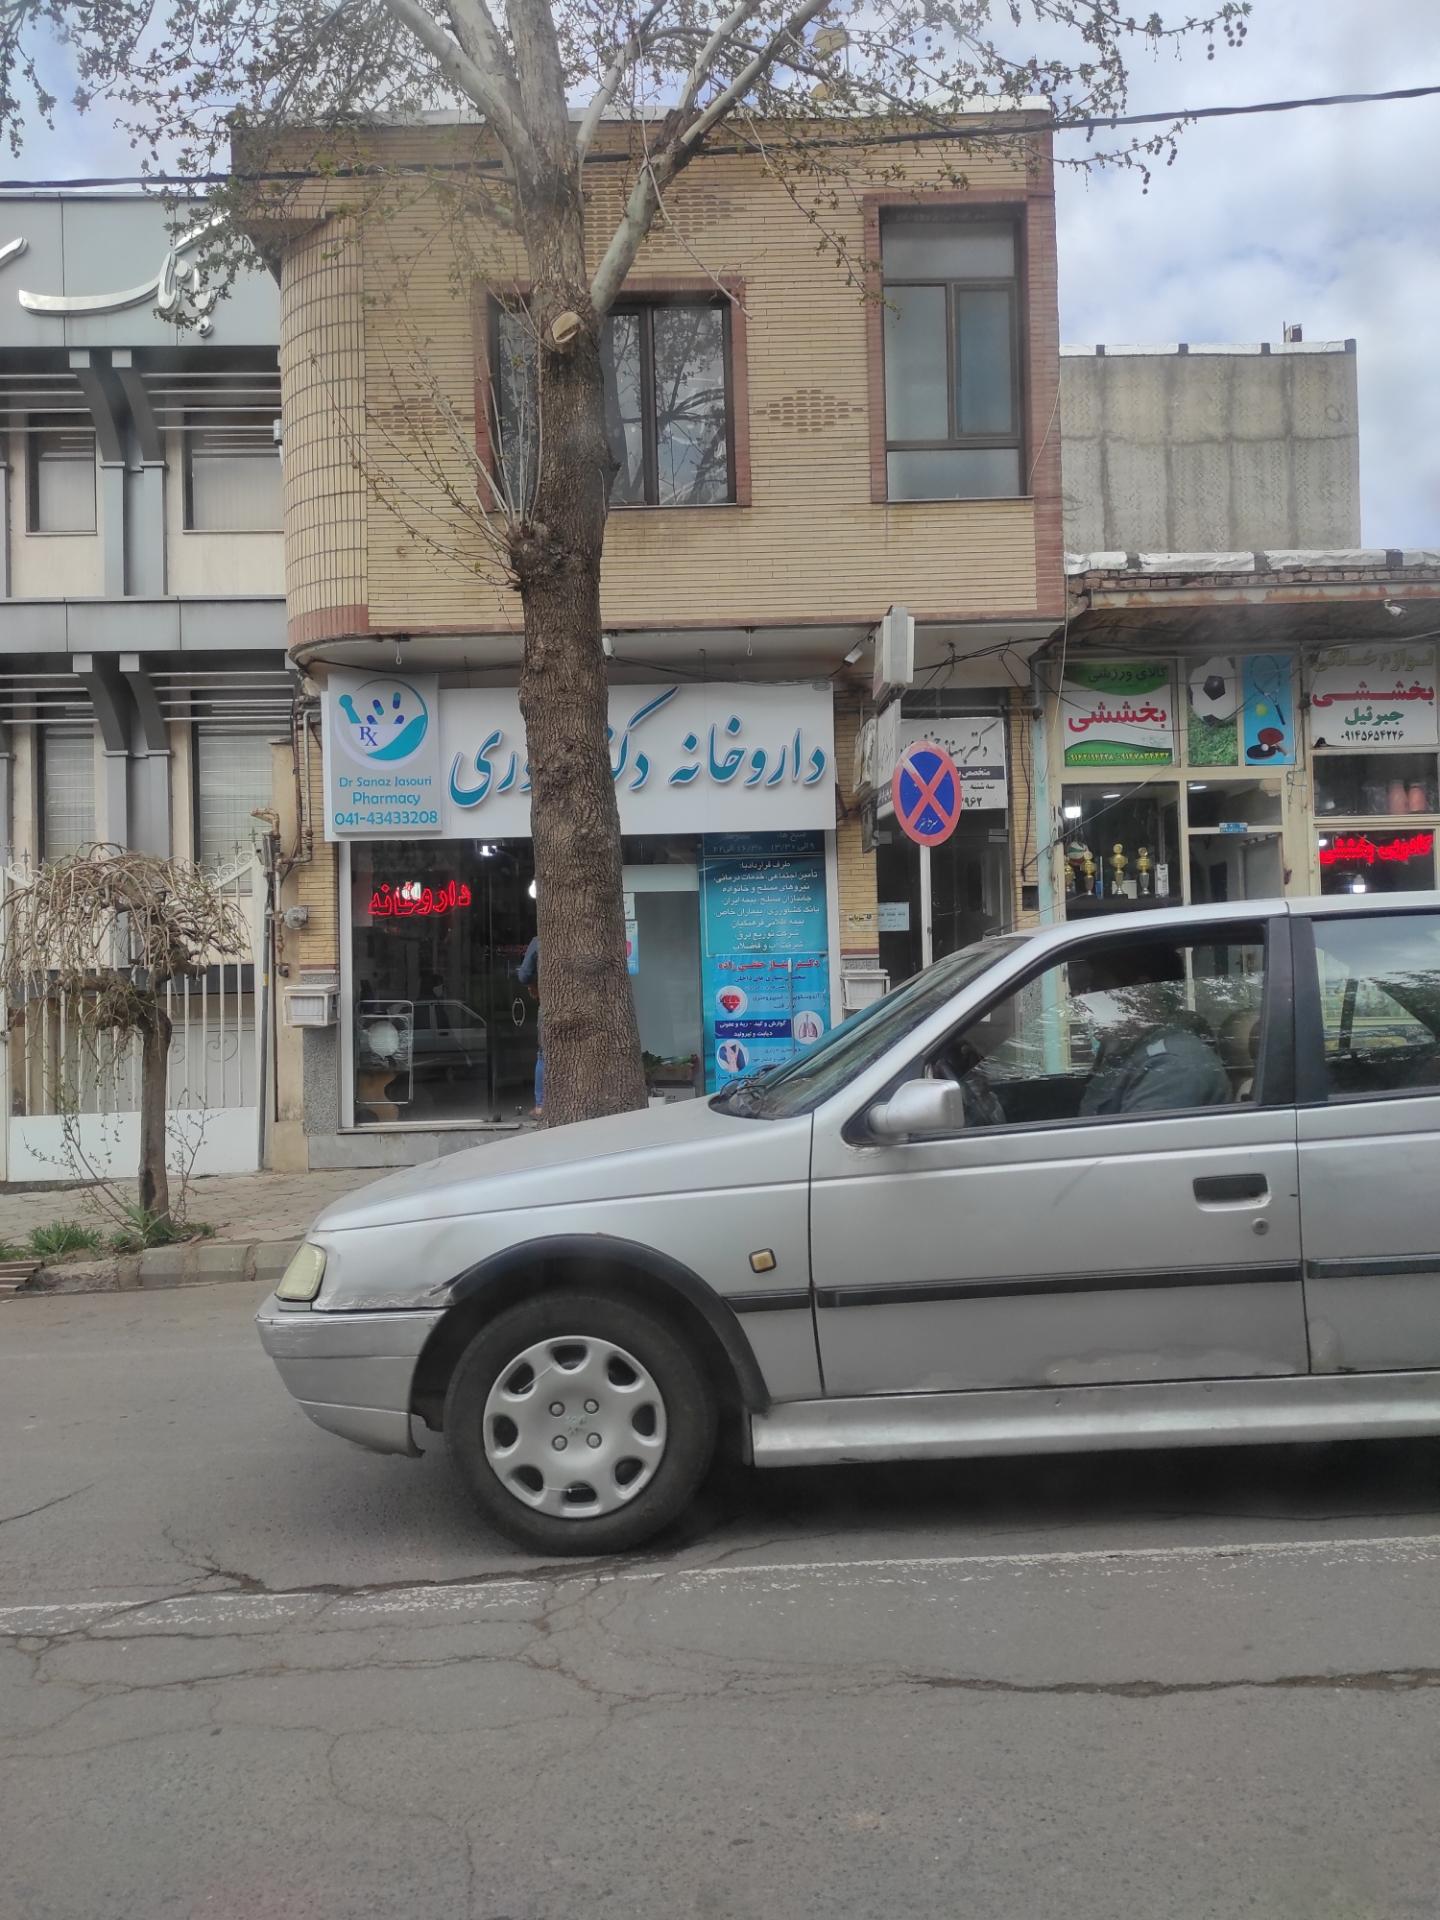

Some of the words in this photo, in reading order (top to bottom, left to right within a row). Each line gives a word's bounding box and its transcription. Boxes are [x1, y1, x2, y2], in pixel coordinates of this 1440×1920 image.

[1088, 668, 1134, 683] ورزشی
[1136, 666, 1168, 681] کالای
[1312, 681, 1434, 707] بخششی
[1068, 701, 1167, 733] بخششی
[1345, 706, 1404, 726] جبرئیل
[965, 720, 999, 760] دکتر
[668, 714, 828, 786] داروخانه
[961, 768, 990, 779] متخصص
[339, 777, 352, 787] Dr
[357, 777, 391, 788] Sanaz
[394, 776, 432, 787] Jasouri
[352, 792, 421, 805] Pharmacy
[334, 811, 438, 826] 041-43433208
[774, 862, 790, 870] طرف
[368, 880, 471, 916] داروخانه
[796, 958, 820, 970] دکتر
